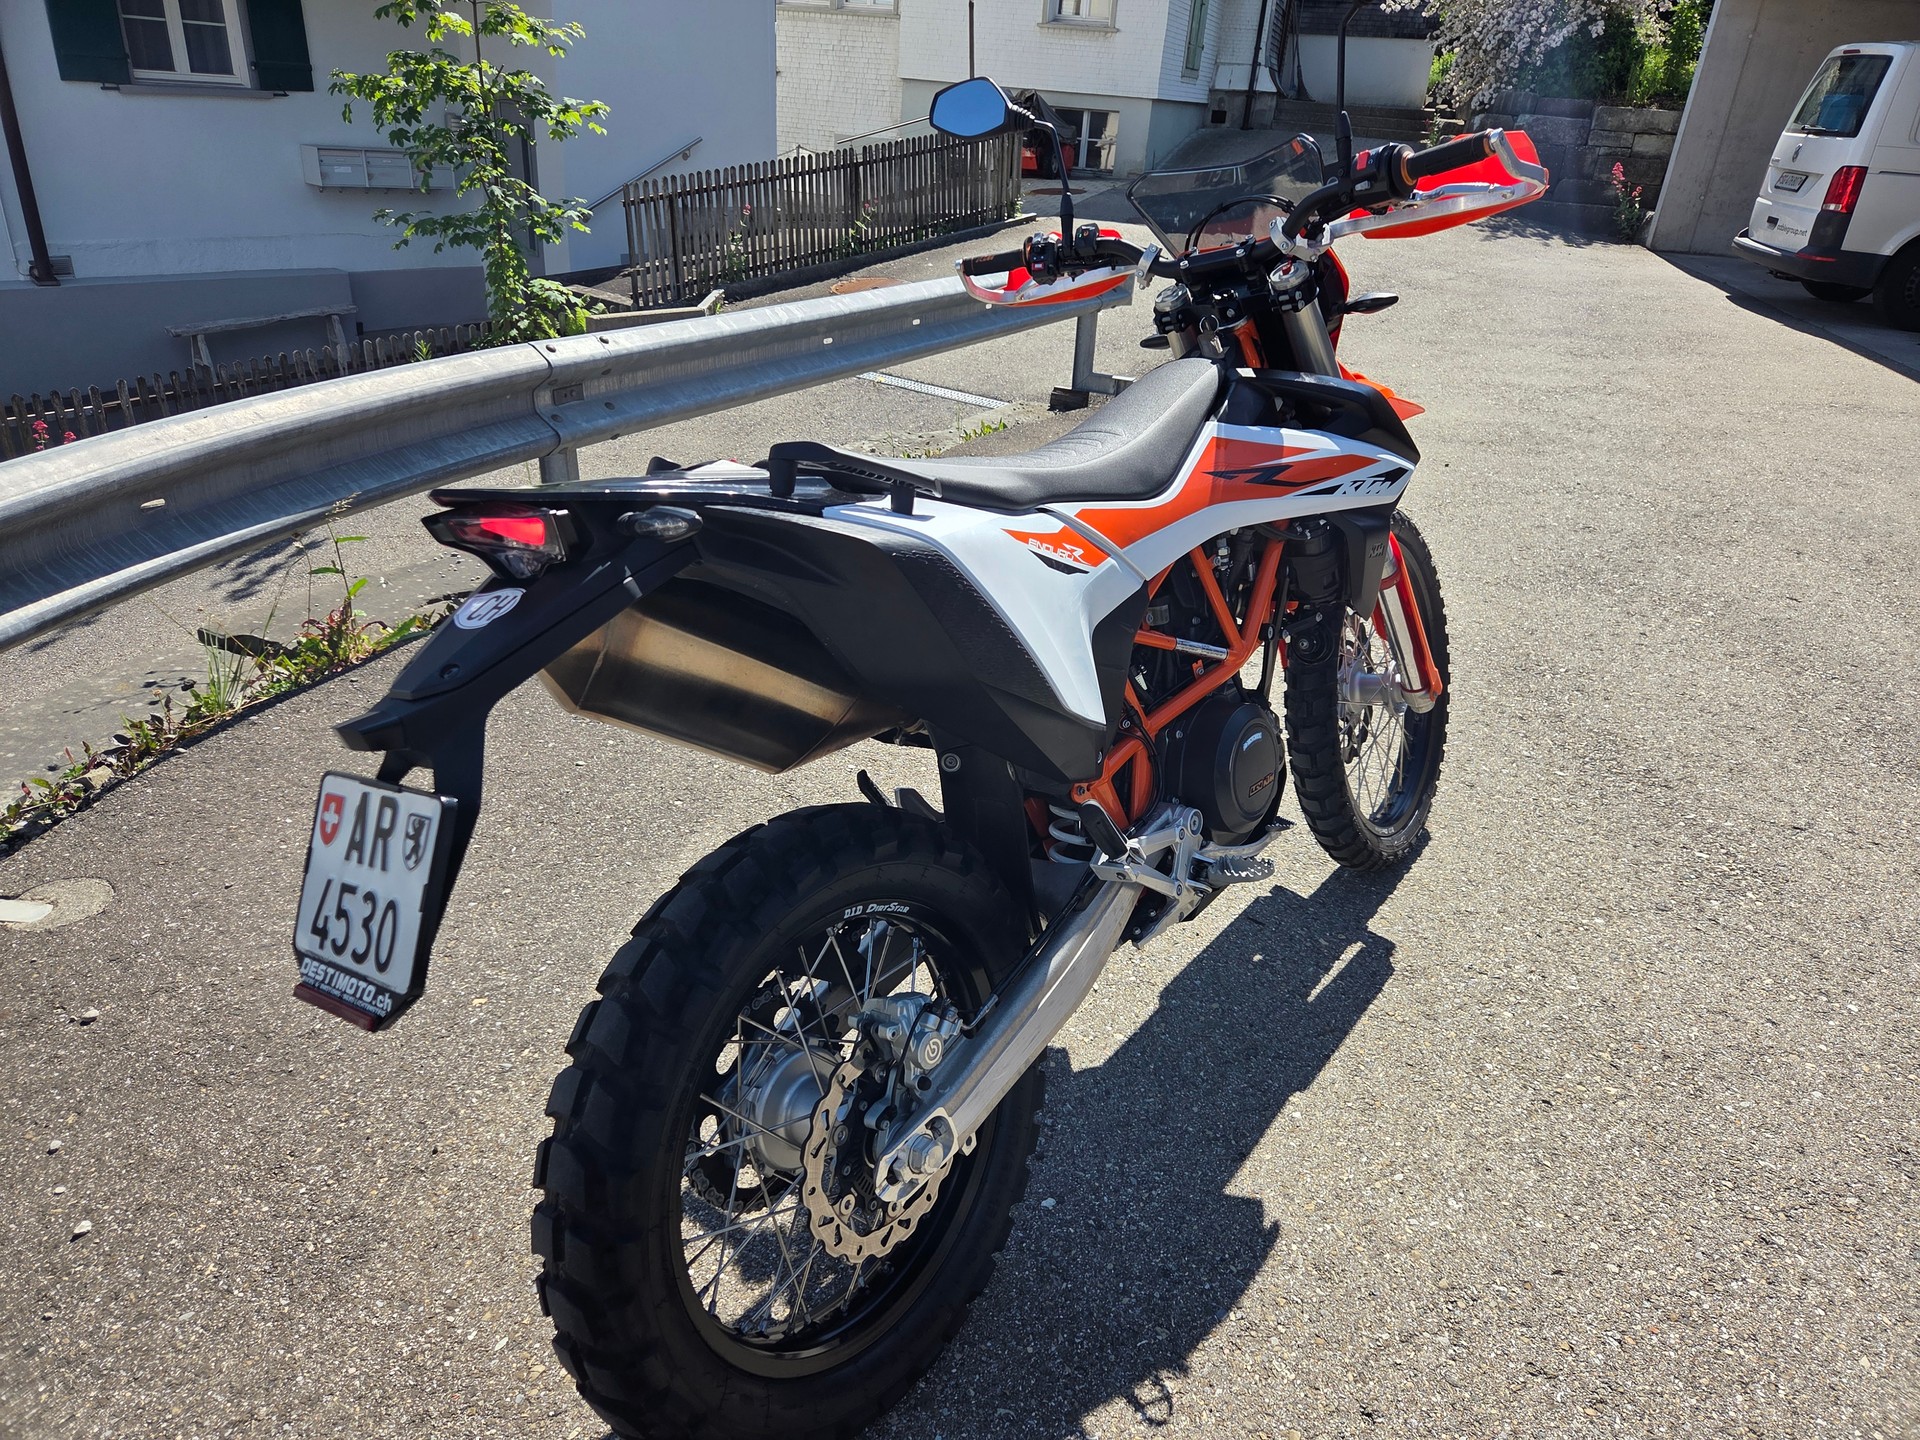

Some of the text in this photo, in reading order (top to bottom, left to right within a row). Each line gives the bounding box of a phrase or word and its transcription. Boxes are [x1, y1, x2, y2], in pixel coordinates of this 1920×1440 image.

[1334, 478, 1394, 496] KTM
[1028, 537, 1074, 561] ENDURO
[466, 595, 519, 621] CH
[344, 791, 400, 872] AR
[310, 878, 398, 974] 4530
[300, 957, 393, 1012] DESTIMOTO.ch
